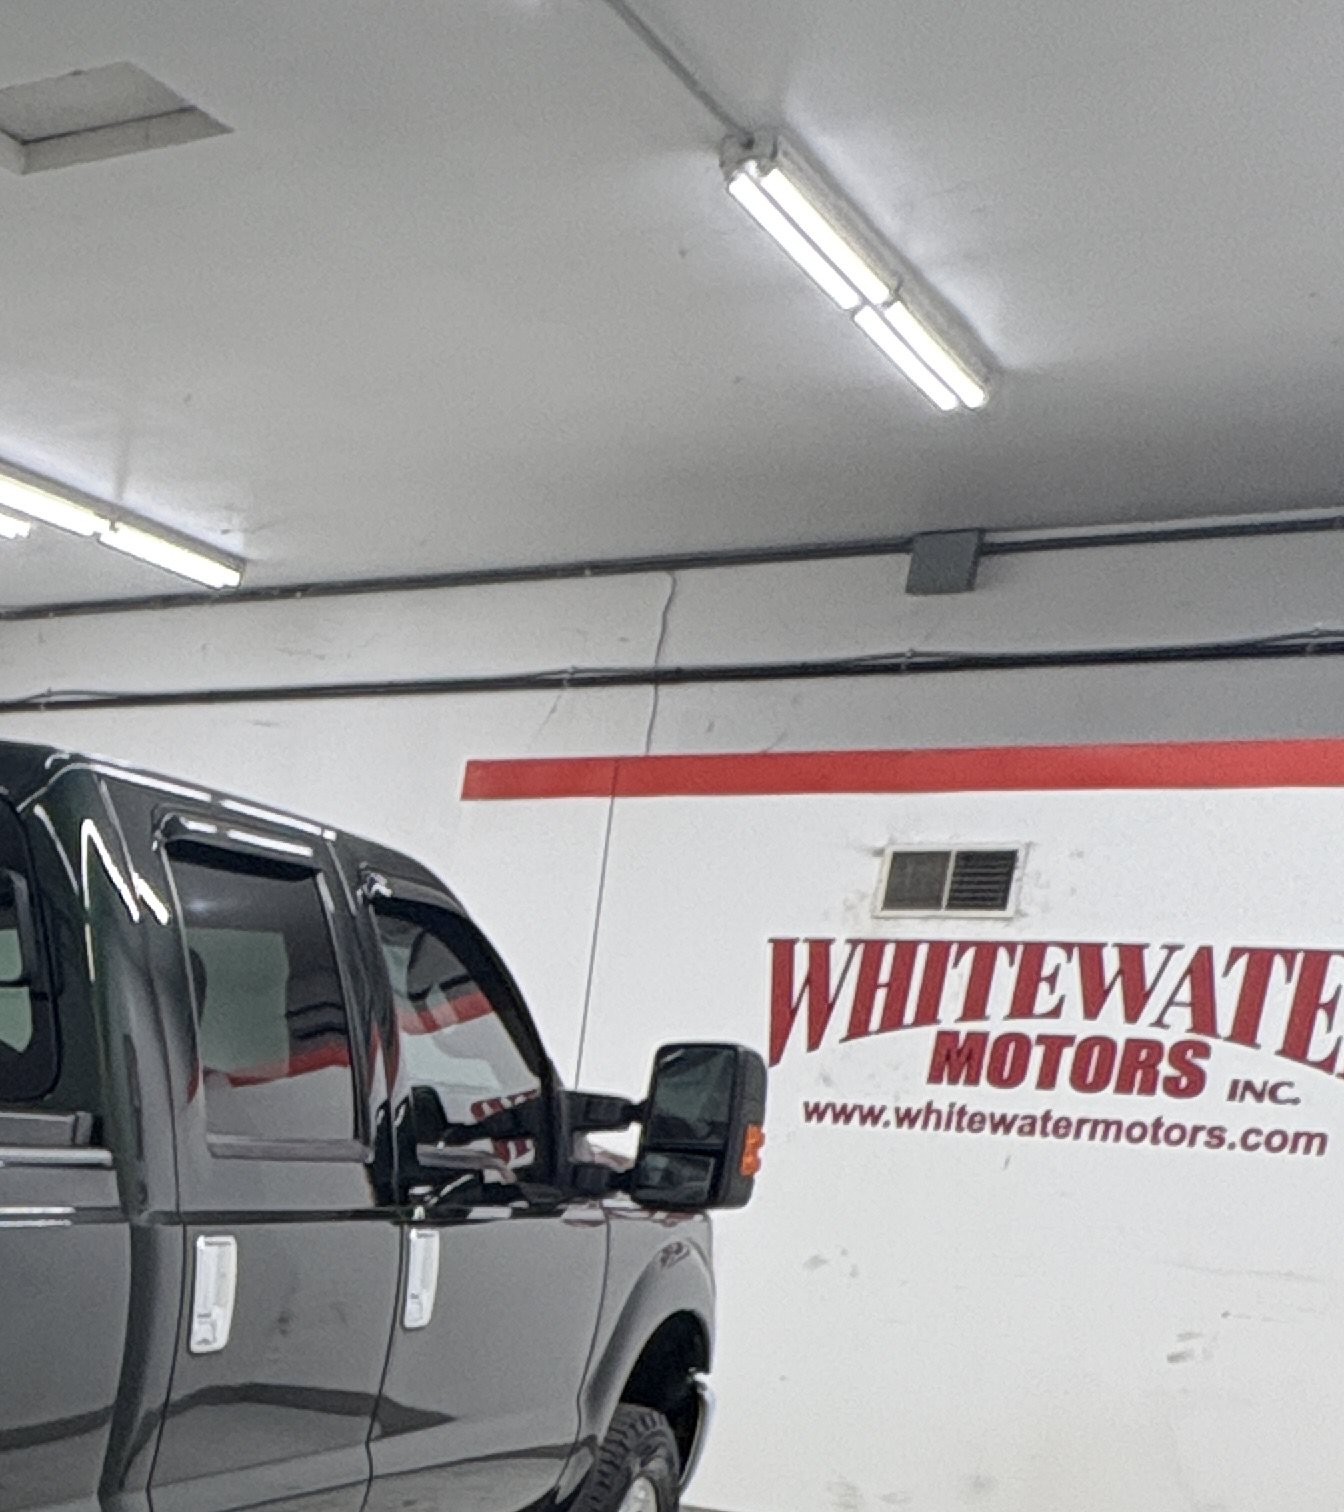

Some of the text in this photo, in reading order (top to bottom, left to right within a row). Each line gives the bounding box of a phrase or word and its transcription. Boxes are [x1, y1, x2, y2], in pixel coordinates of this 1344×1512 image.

[767, 936, 1344, 1080] WHITEWATE
[926, 1030, 1301, 1105] MOTORS INC.
[803, 1100, 1329, 1156] www.whitewatermotors.com
